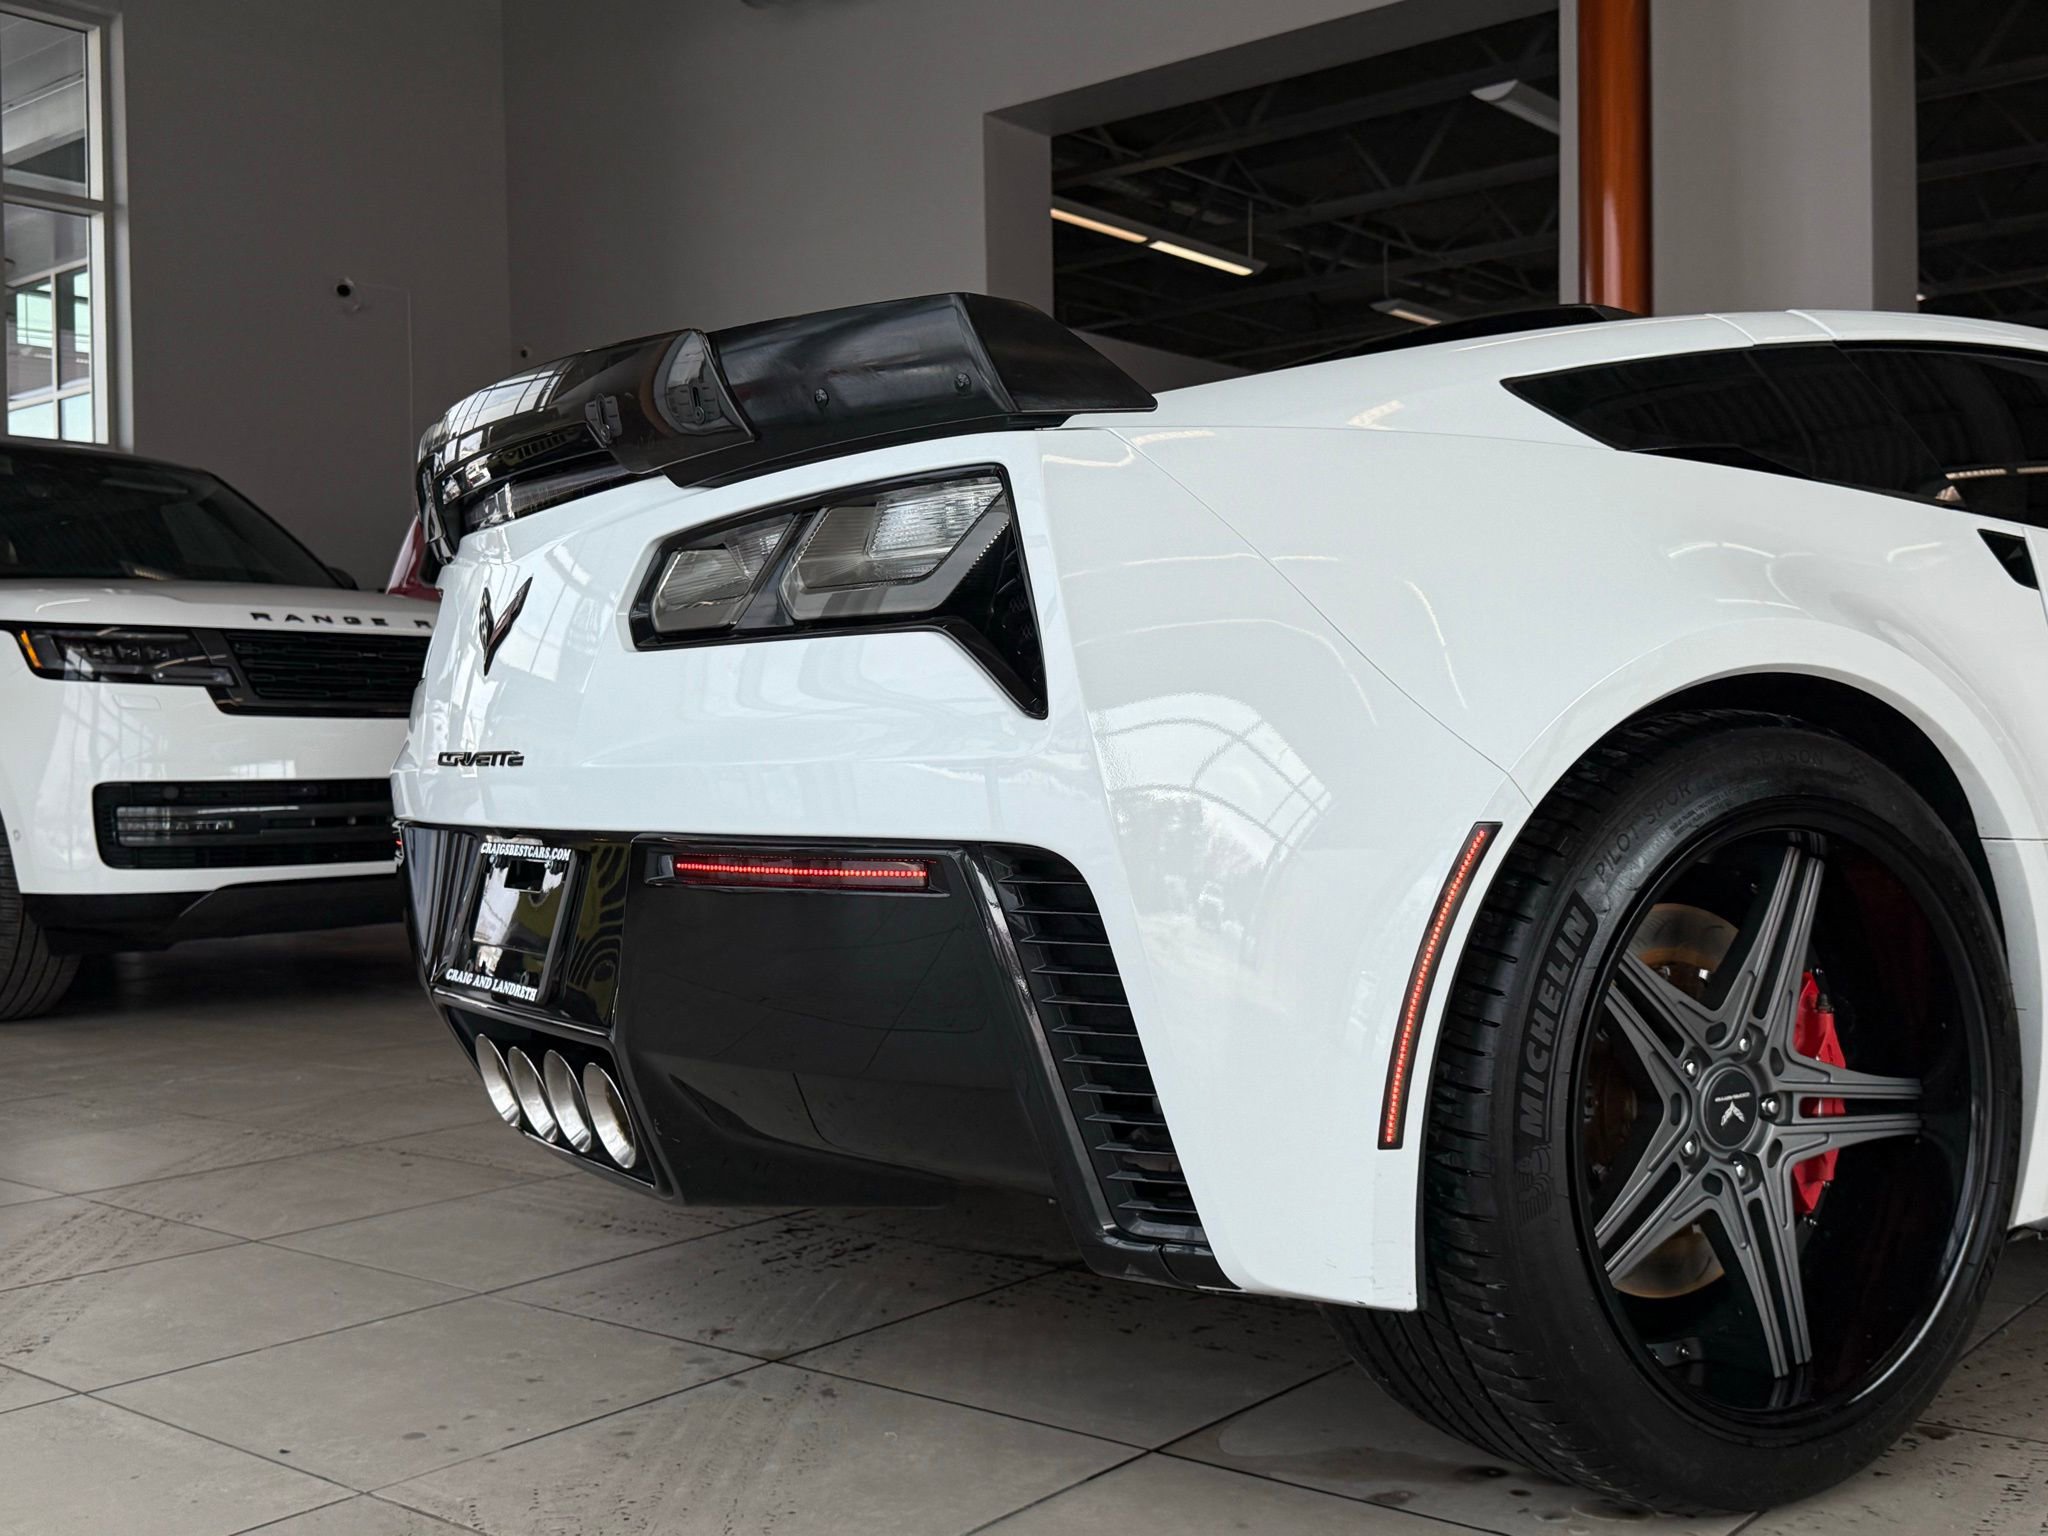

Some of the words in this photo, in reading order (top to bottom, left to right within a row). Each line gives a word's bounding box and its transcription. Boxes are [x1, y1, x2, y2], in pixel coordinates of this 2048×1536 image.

[250, 612, 389, 627] RANGE
[437, 750, 525, 767] CORVETTE
[480, 842, 571, 861] CRAIGSBESTCARS.COM
[1594, 824, 1640, 884] PILOT
[445, 968, 473, 985] CRAIG
[473, 975, 493, 990] AND
[492, 978, 538, 1002] LANDRETH
[1519, 904, 1590, 1139] MICHELIN
